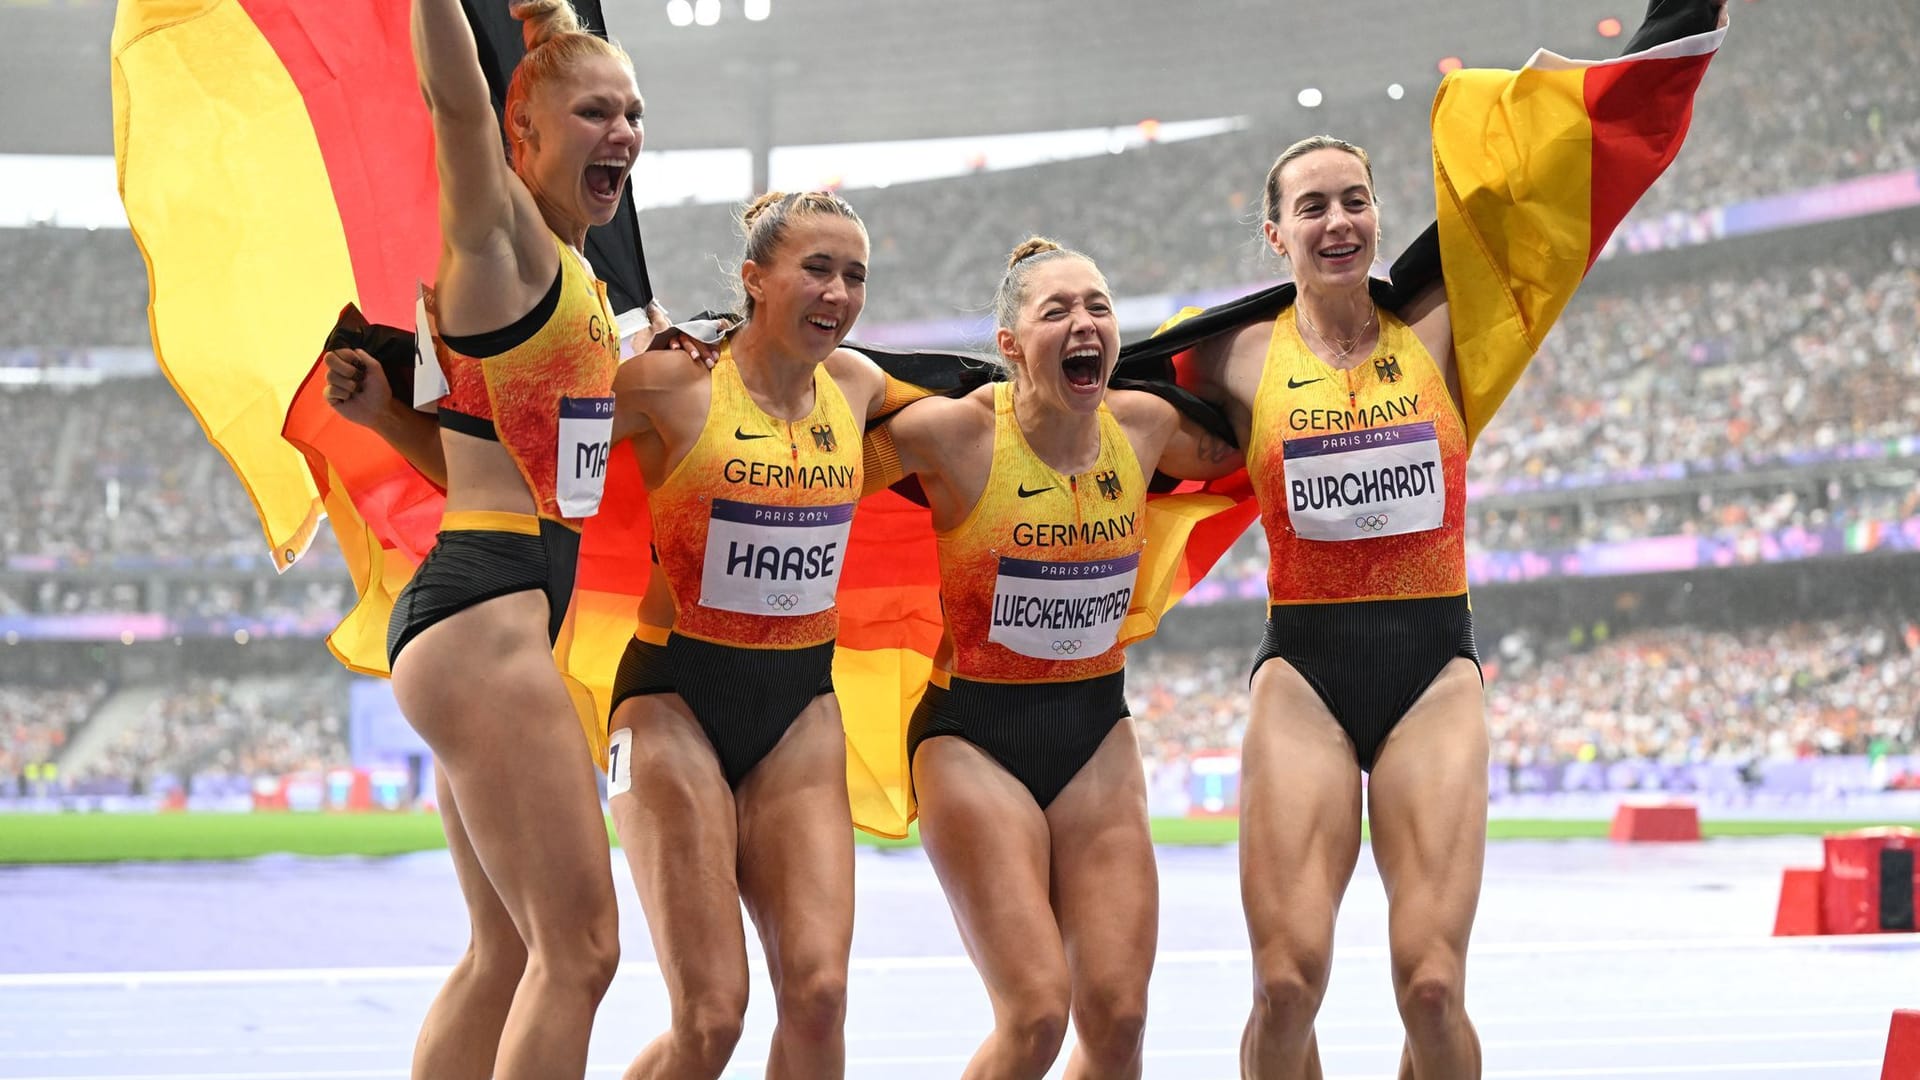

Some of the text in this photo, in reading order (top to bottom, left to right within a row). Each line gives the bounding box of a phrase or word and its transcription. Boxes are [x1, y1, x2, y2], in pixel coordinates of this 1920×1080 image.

[1289, 394, 1419, 431] GERMANY
[1322, 430, 1400, 449] PARIS 2024
[724, 458, 855, 489] GERMANY
[1291, 461, 1436, 512] BURGHARDT
[755, 510, 829, 522] PARIS 2024
[1013, 512, 1136, 547] GERMANY
[726, 541, 837, 581] HAASE
[1041, 564, 1113, 576] PARIS 2024
[993, 587, 1131, 630] LUECKENKEMPER
